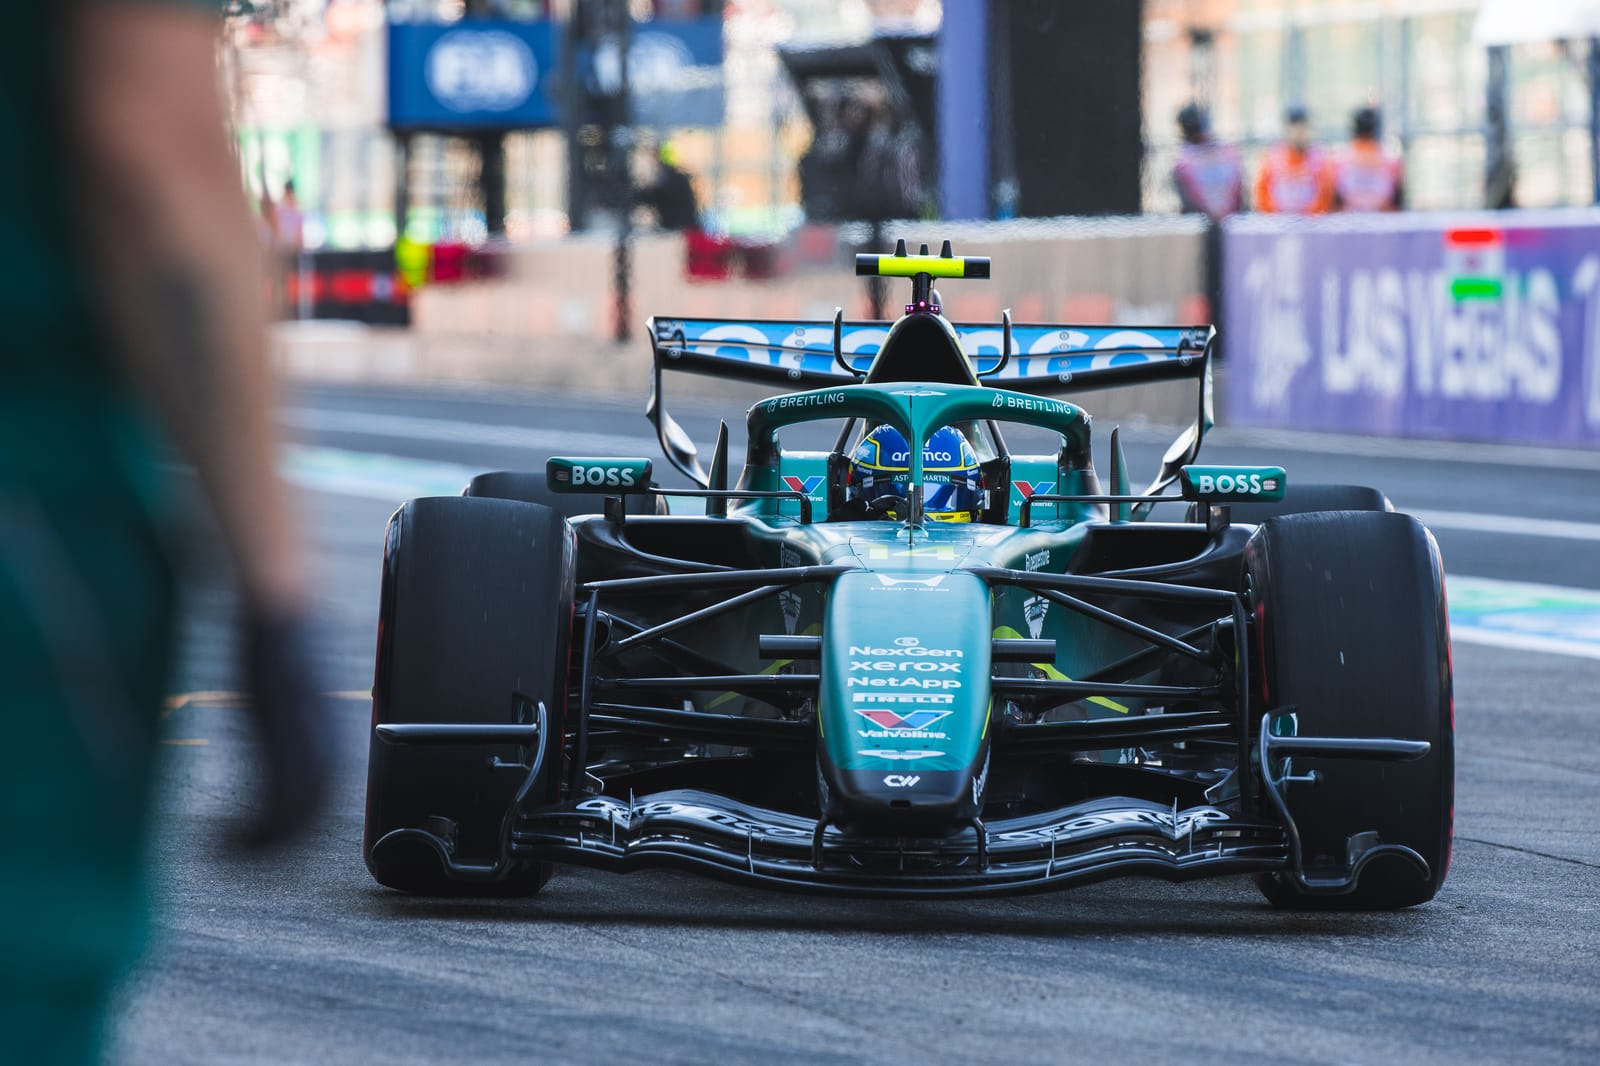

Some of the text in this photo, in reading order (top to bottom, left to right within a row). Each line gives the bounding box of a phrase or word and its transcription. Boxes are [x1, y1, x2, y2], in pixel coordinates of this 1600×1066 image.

[779, 392, 845, 409] BREITLING
[1007, 396, 1072, 415] BREITLING
[891, 450, 951, 463] armco
[572, 465, 635, 487] BOSS
[1199, 473, 1262, 495] BOSS
[849, 646, 963, 658] NexGen
[849, 661, 962, 673] xerox
[847, 677, 962, 689] NetApp
[852, 692, 955, 704] PIRELLI
[857, 729, 947, 739] Valvoline
